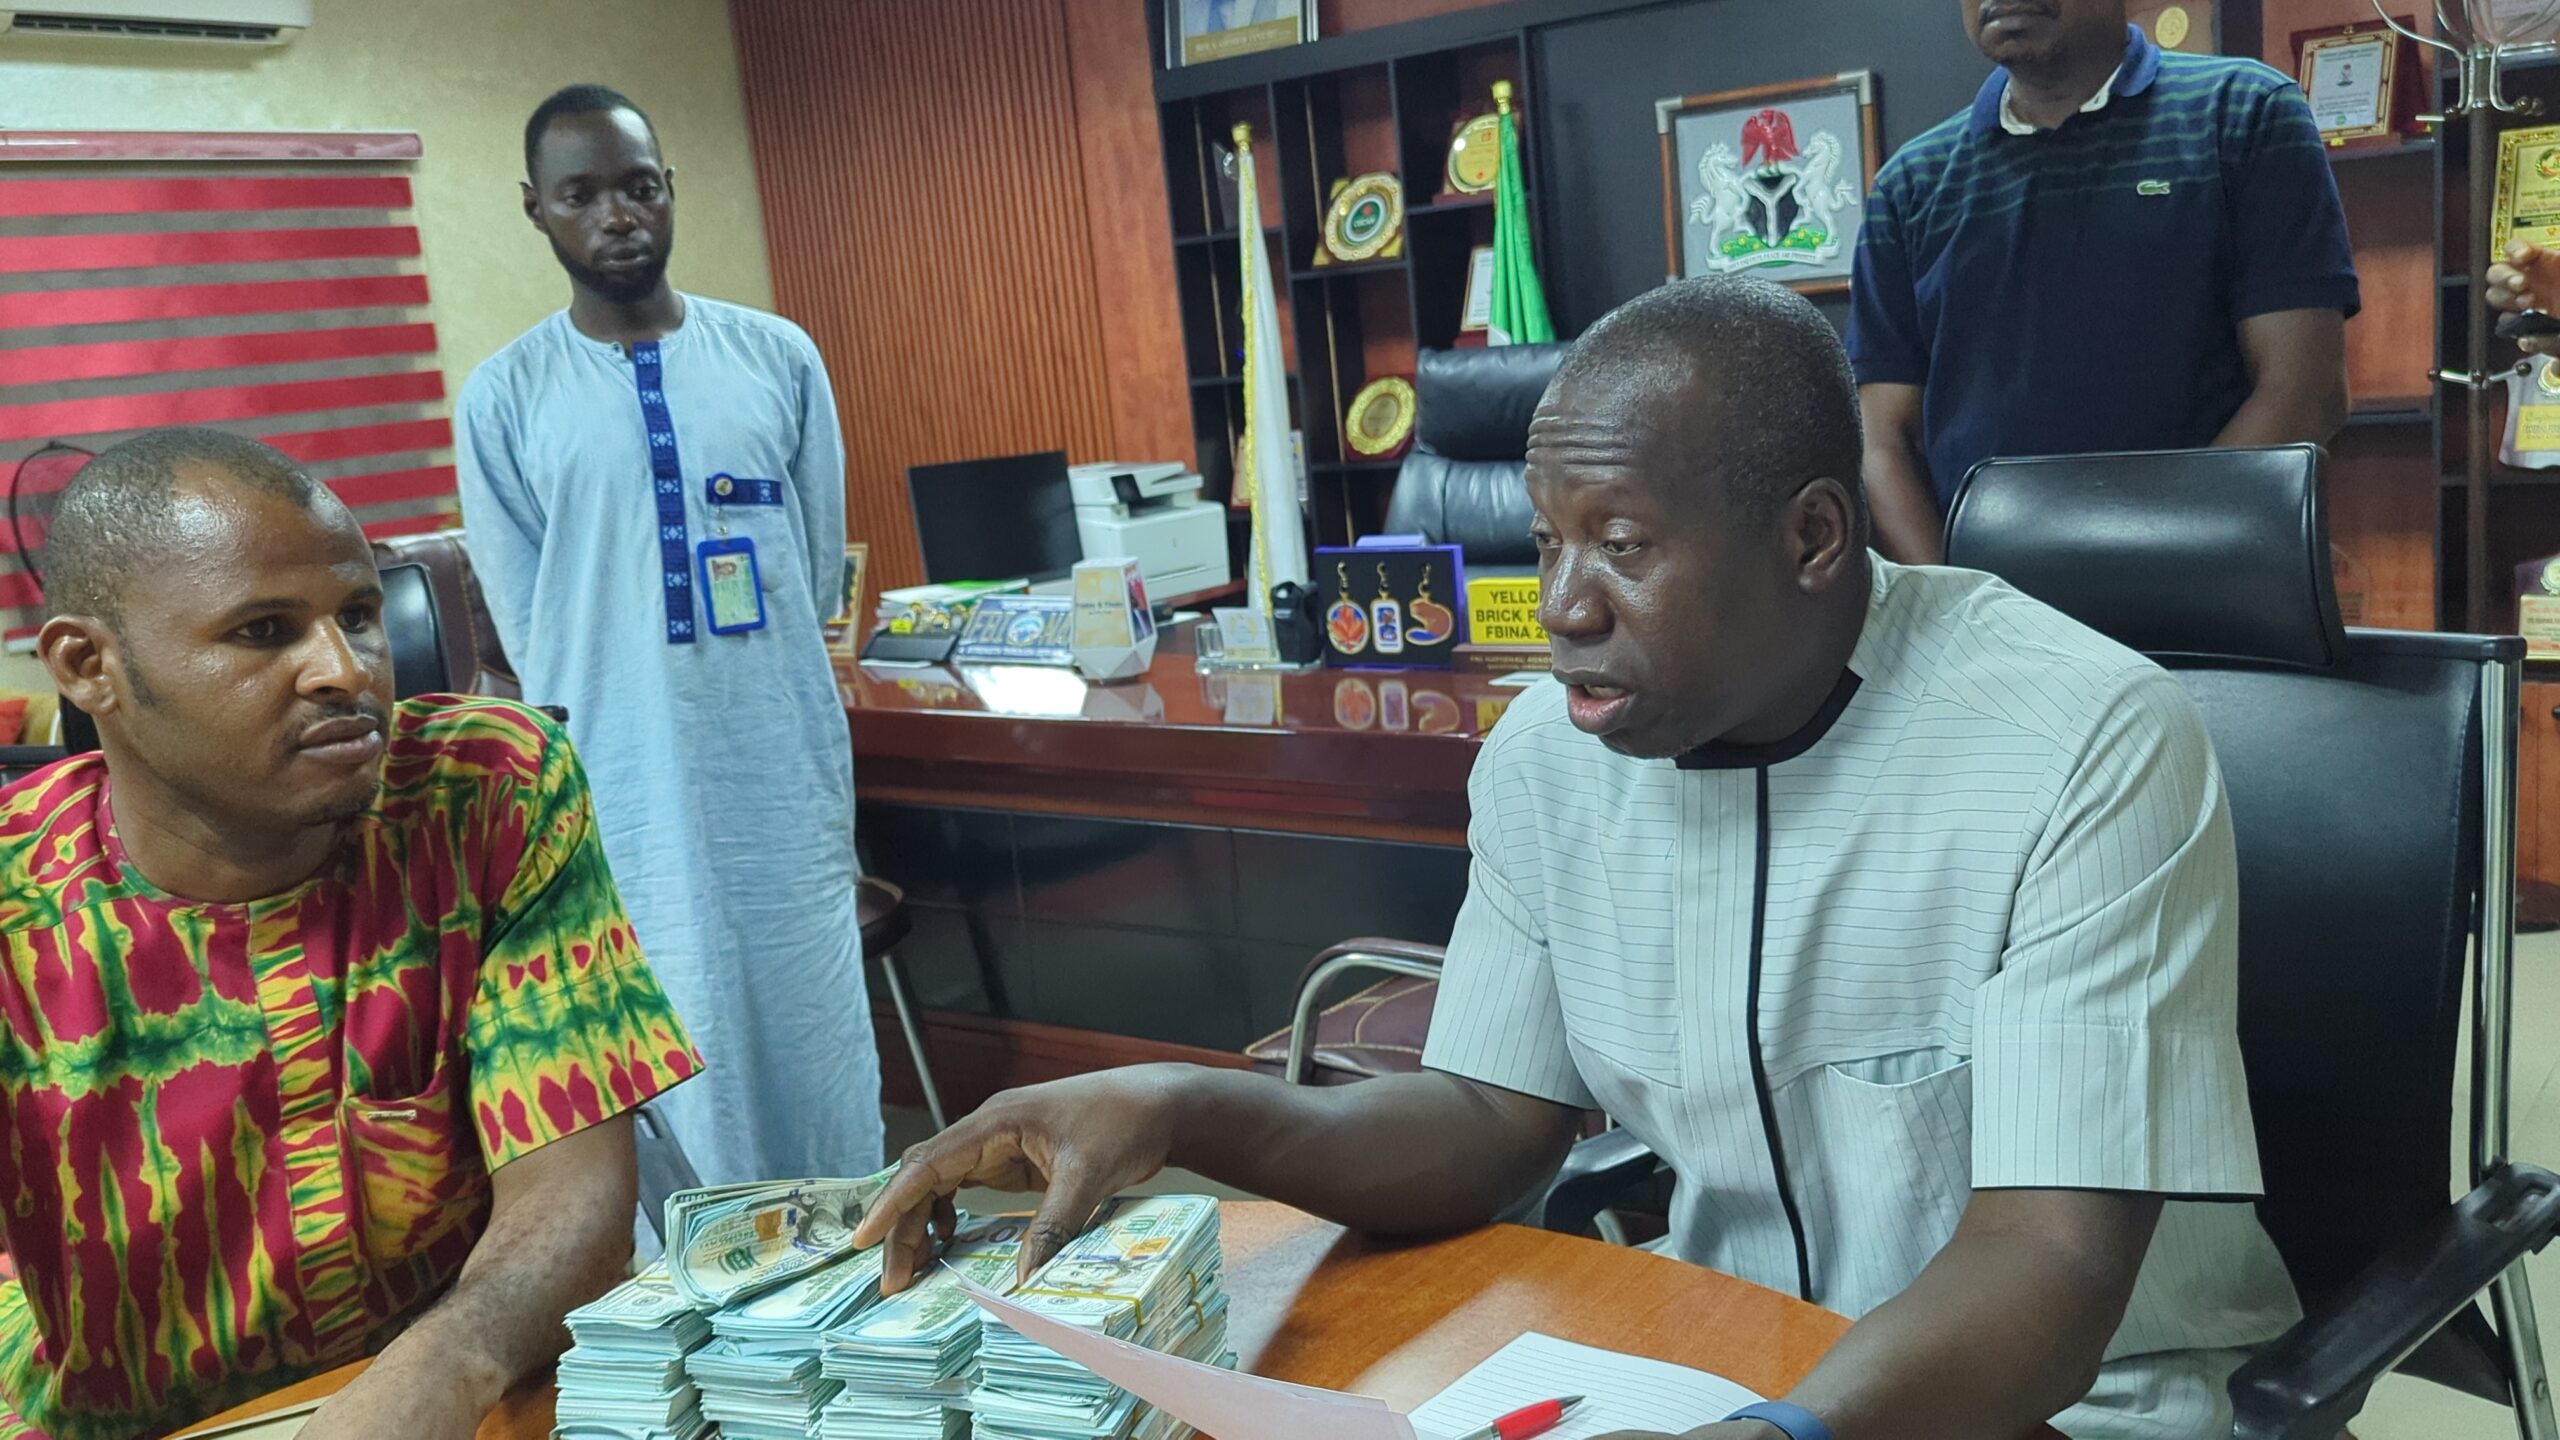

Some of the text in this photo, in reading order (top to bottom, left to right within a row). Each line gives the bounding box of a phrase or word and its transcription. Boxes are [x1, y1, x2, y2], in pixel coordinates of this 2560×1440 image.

[1489, 590, 1538, 604] YELLO
[1476, 609, 1522, 622] BRICK
[1486, 626, 1530, 639] FBINA
